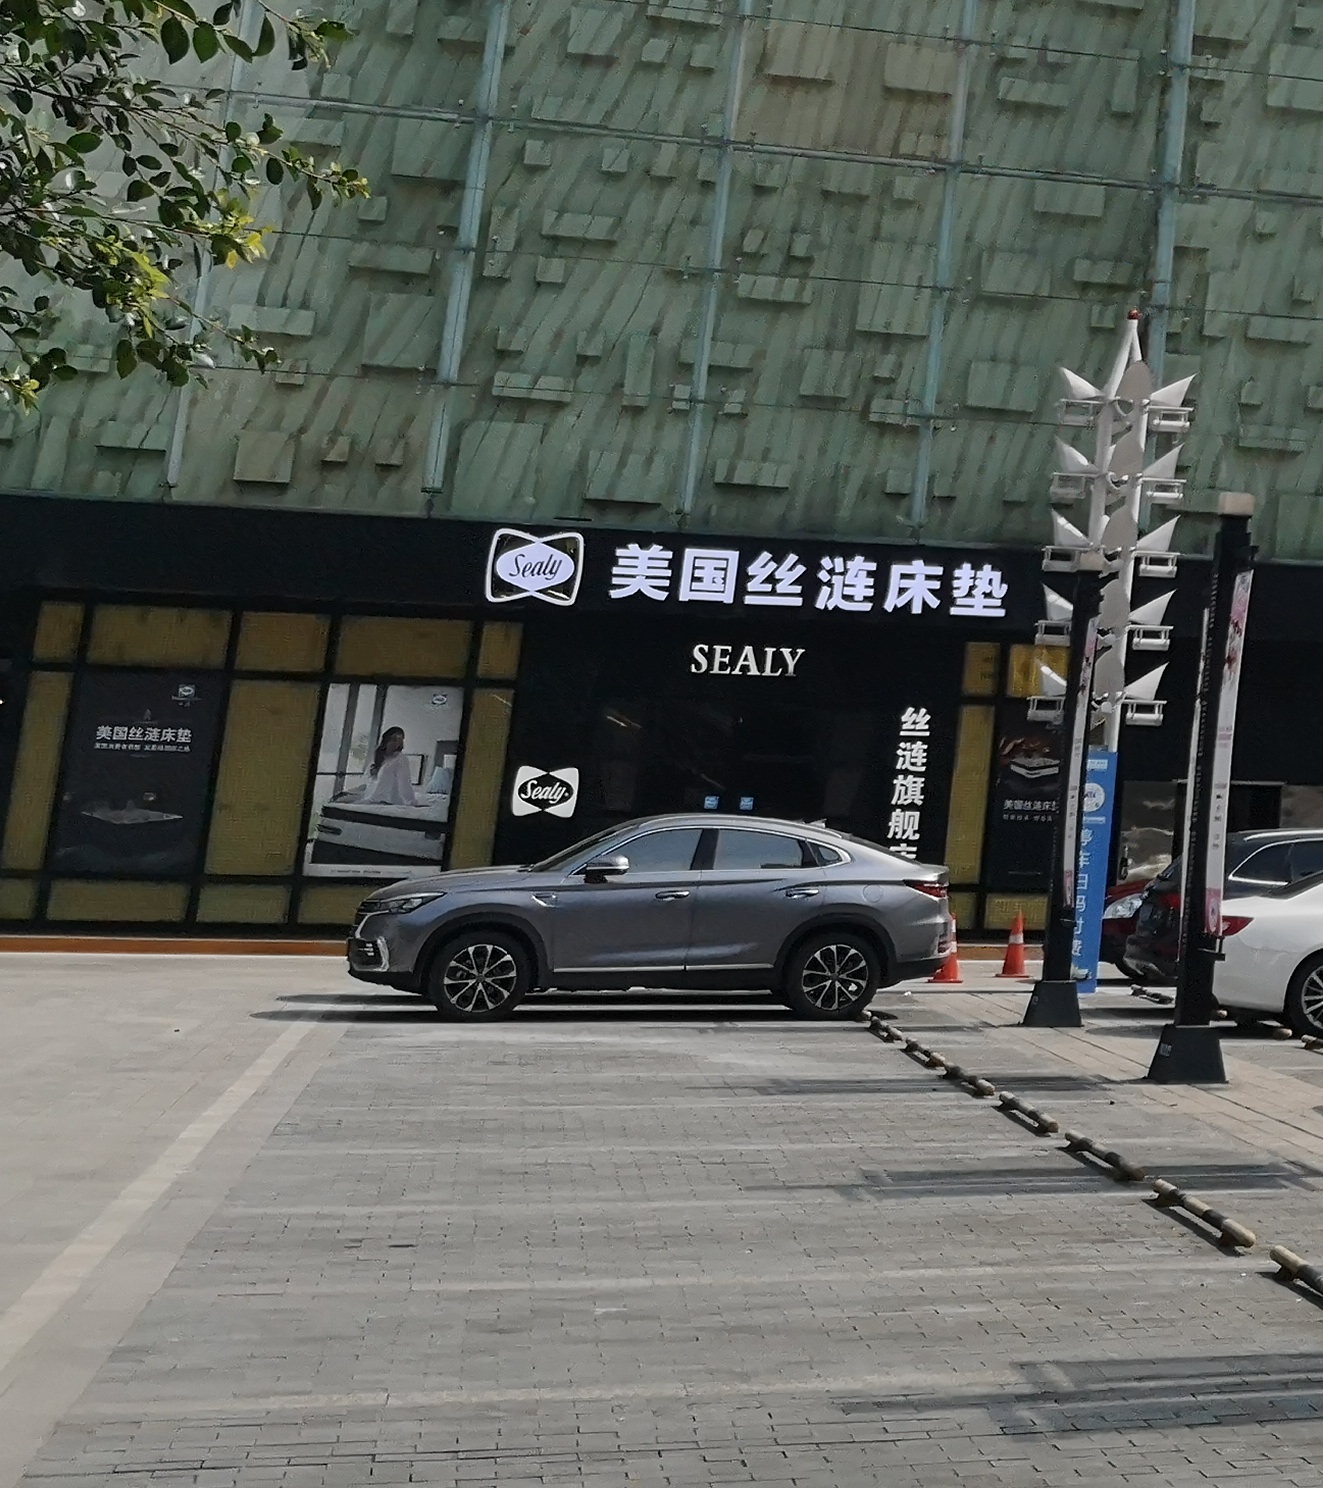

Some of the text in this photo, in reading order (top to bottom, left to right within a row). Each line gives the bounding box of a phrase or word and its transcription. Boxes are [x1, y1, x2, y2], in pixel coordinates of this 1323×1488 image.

[508, 553, 563, 581] Sealy
[608, 543, 1009, 618] 美国丝涟床垫
[690, 644, 806, 679] SEALY
[96, 725, 193, 744] 美国丝涟床垫
[520, 780, 568, 805] Sealy
